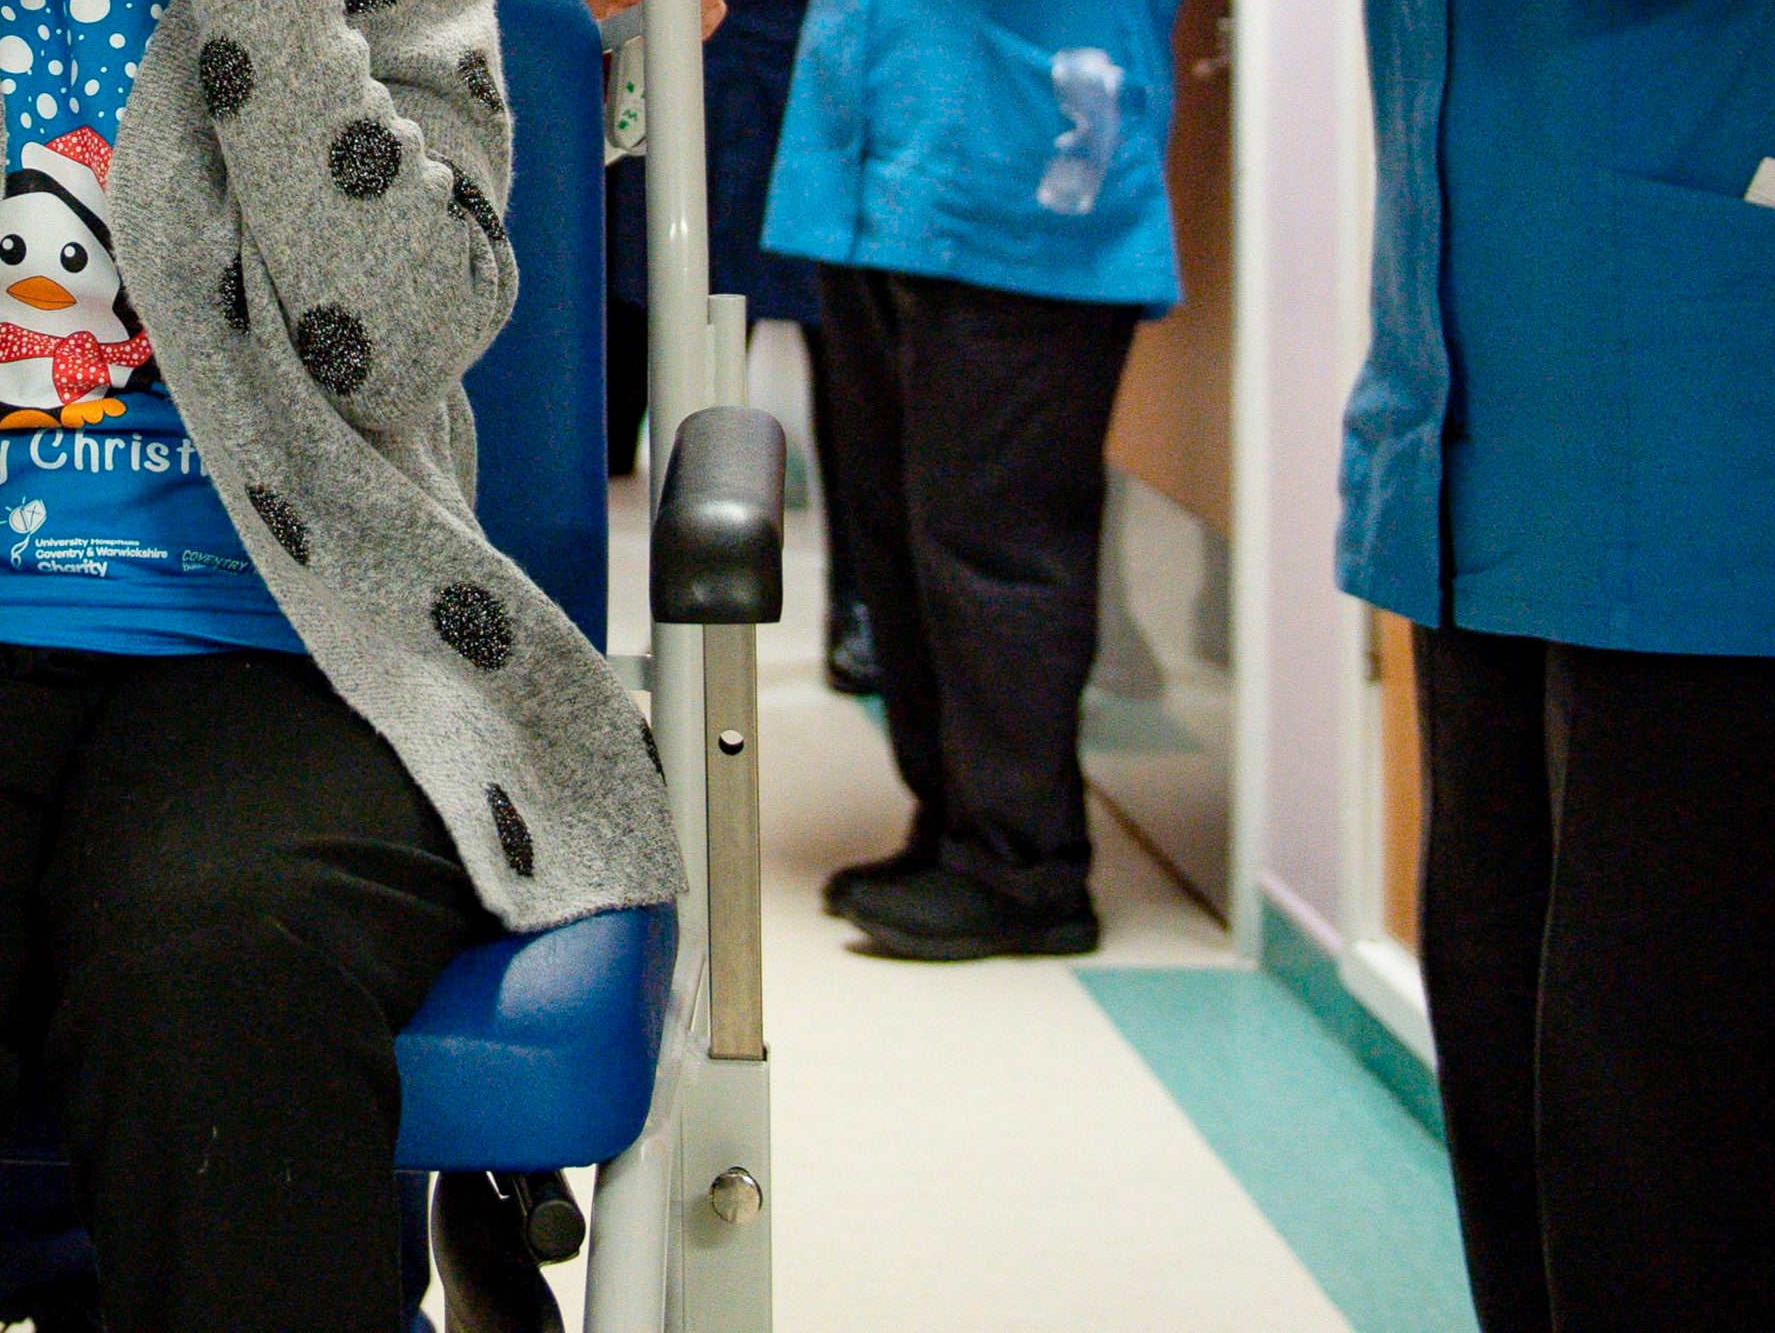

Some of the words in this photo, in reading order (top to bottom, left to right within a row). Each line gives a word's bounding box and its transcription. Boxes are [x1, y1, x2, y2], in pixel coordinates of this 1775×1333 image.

[35, 538, 89, 548] University
[35, 548, 84, 559] Coventry
[86, 547, 95, 557] &
[96, 546, 168, 559] Warwickshire
[37, 559, 108, 577] Charity
